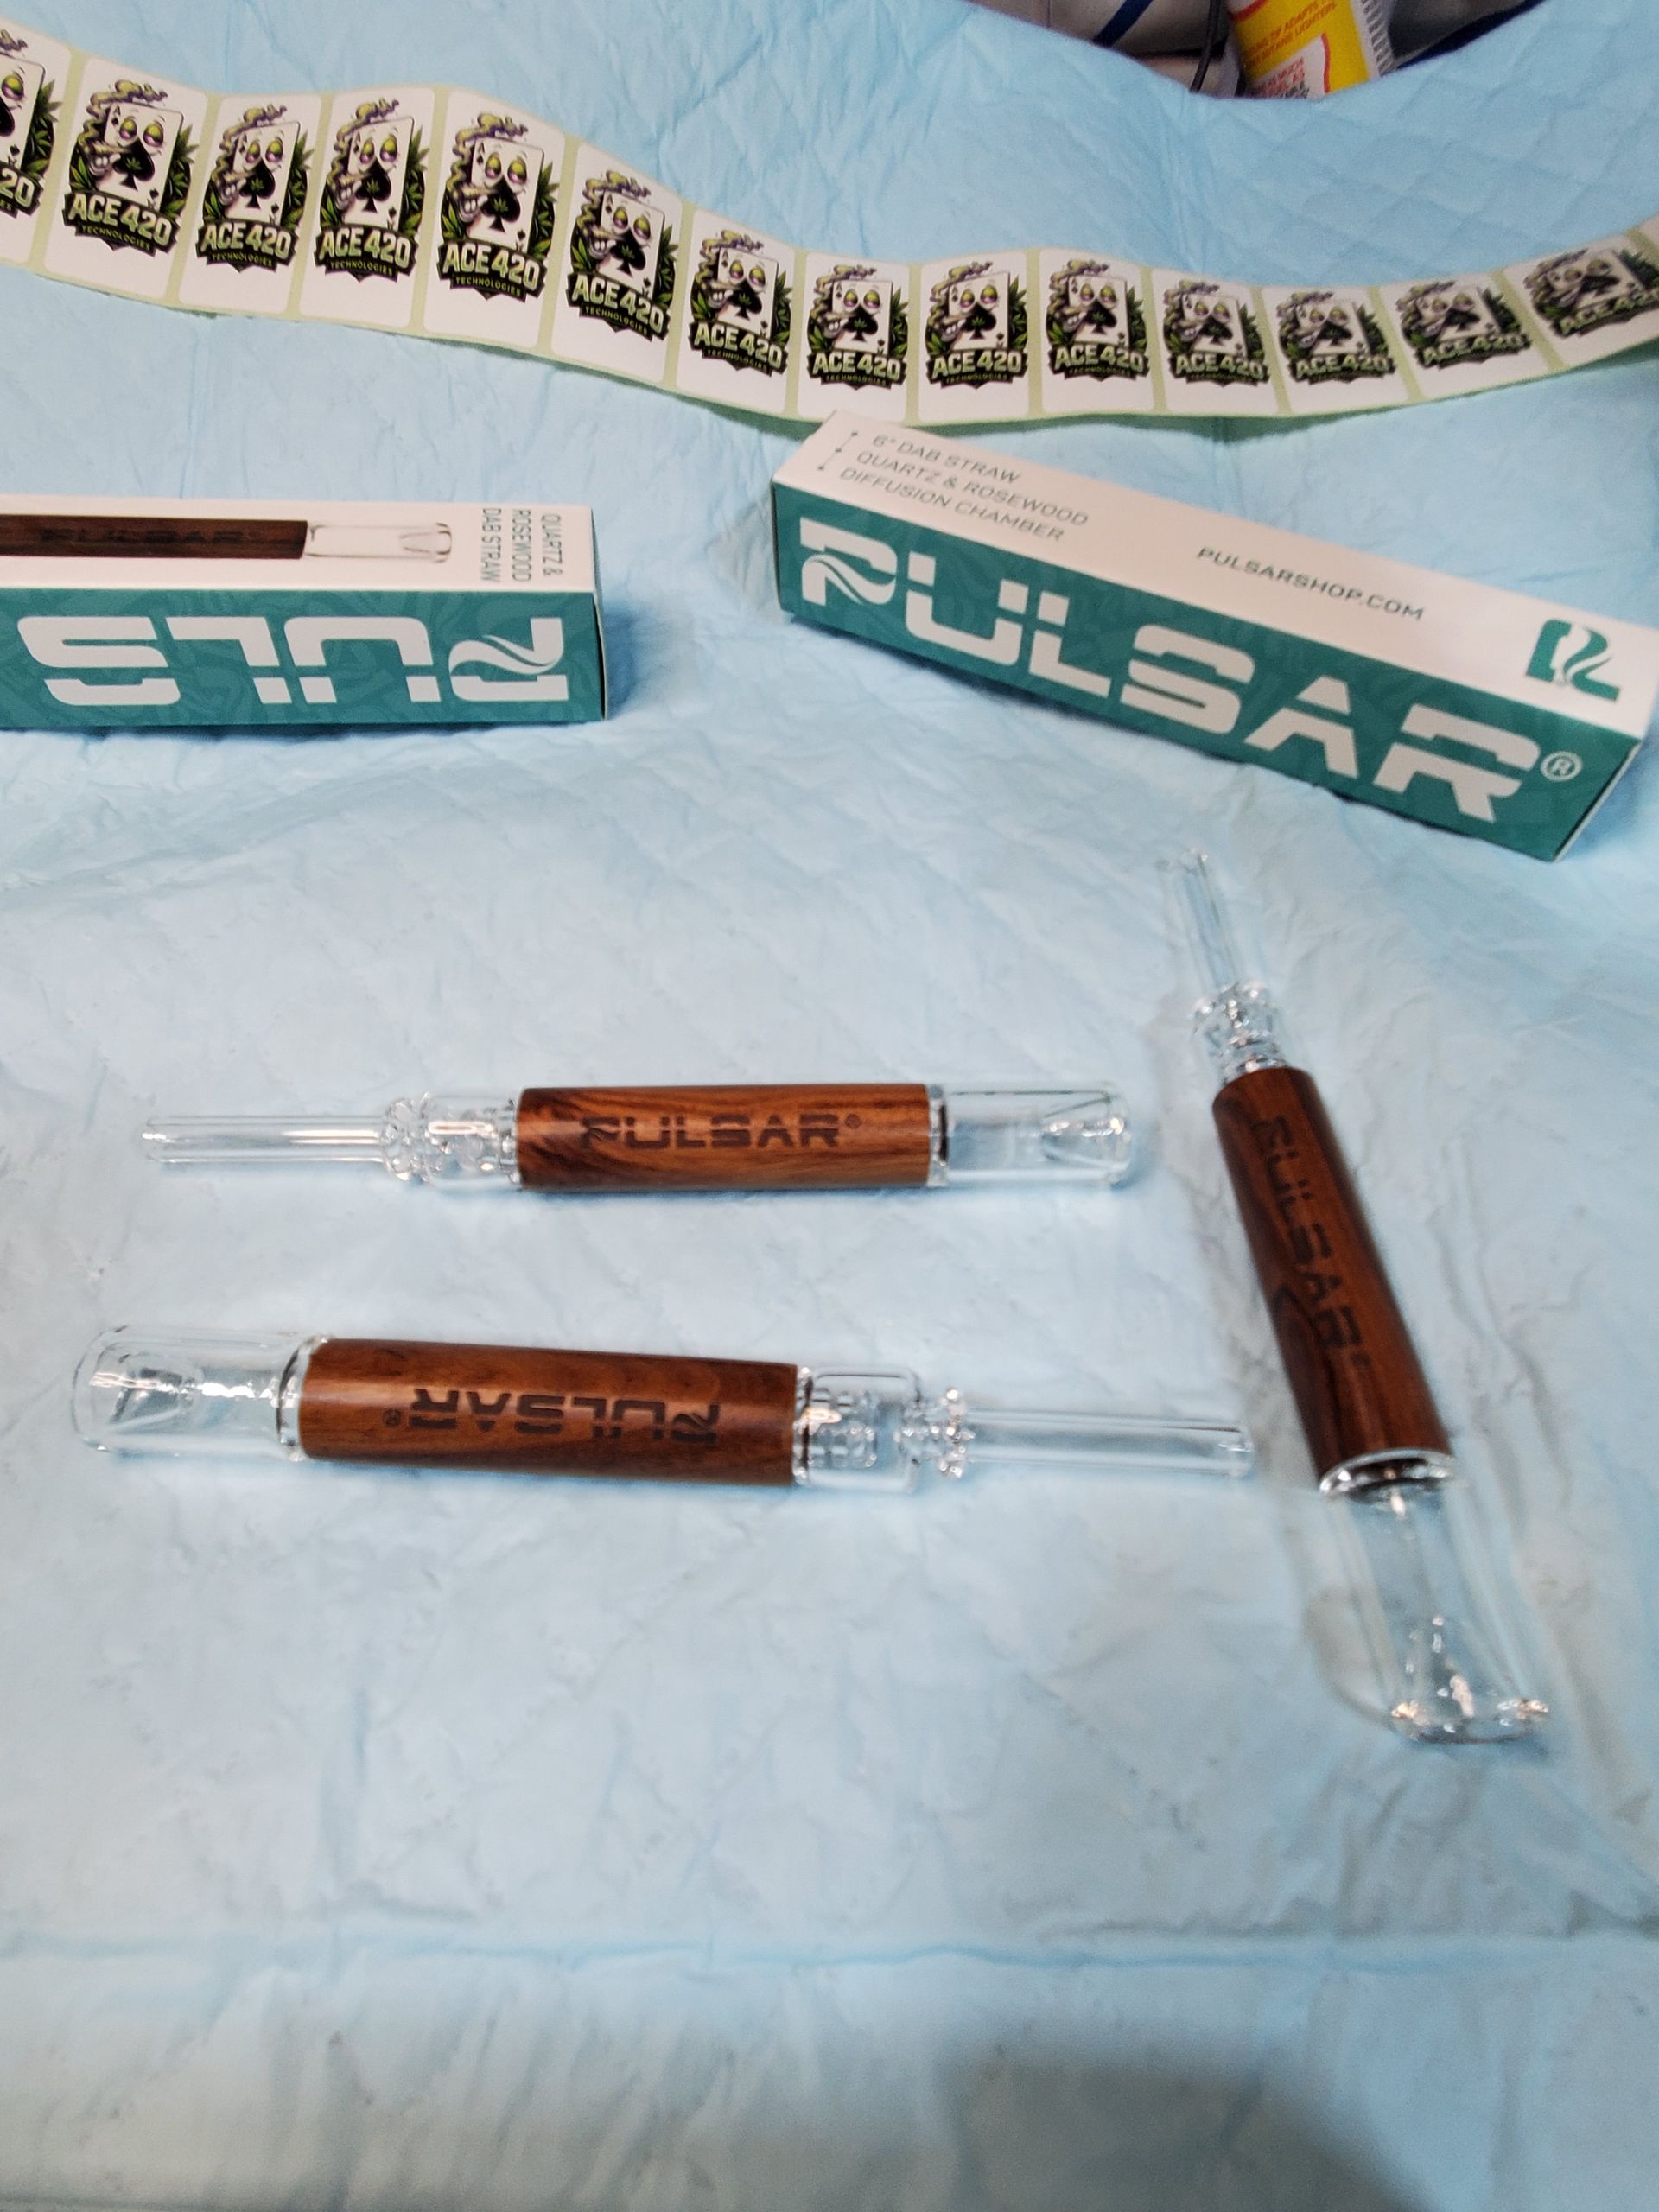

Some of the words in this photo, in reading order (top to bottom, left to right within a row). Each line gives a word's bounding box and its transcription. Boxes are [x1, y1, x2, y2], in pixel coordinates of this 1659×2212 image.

[68, 193, 123, 227] ACE
[120, 204, 172, 246] 420
[200, 222, 248, 252] ACE
[245, 228, 291, 259] 420
[319, 226, 365, 259] ACE
[364, 229, 411, 269] 420
[330, 260, 393, 276] TECHNOLOGIES
[442, 242, 490, 275] ACE
[491, 247, 541, 290] 420
[455, 275, 522, 296] TECHNOLOGIES
[571, 274, 620, 309] ACE
[618, 289, 664, 334] 420
[694, 322, 739, 351] ACE
[738, 333, 783, 369] 420
[812, 351, 857, 374] ACE
[856, 355, 902, 381] 420
[932, 351, 976, 378] ACE
[976, 351, 1022, 372] 420
[1054, 346, 1099, 370] ACE
[1100, 346, 1145, 372] 420
[1176, 353, 1219, 375] ACE
[896, 441, 942, 462] DAB
[944, 454, 1021, 484] STRAW
[839, 466, 952, 508] DIFFUSION
[954, 500, 1065, 542] CHAMBER
[856, 451, 941, 482] QUARTZ
[943, 475, 958, 490] &
[963, 480, 1090, 527] ROSEWOOD
[482, 507, 502, 532] DAB
[541, 513, 563, 565] QUARTZ
[480, 534, 502, 583] STRAW
[512, 508, 532, 582] ROSEWOOD
[1196, 546, 1425, 620] PULSARSHOP.COM
